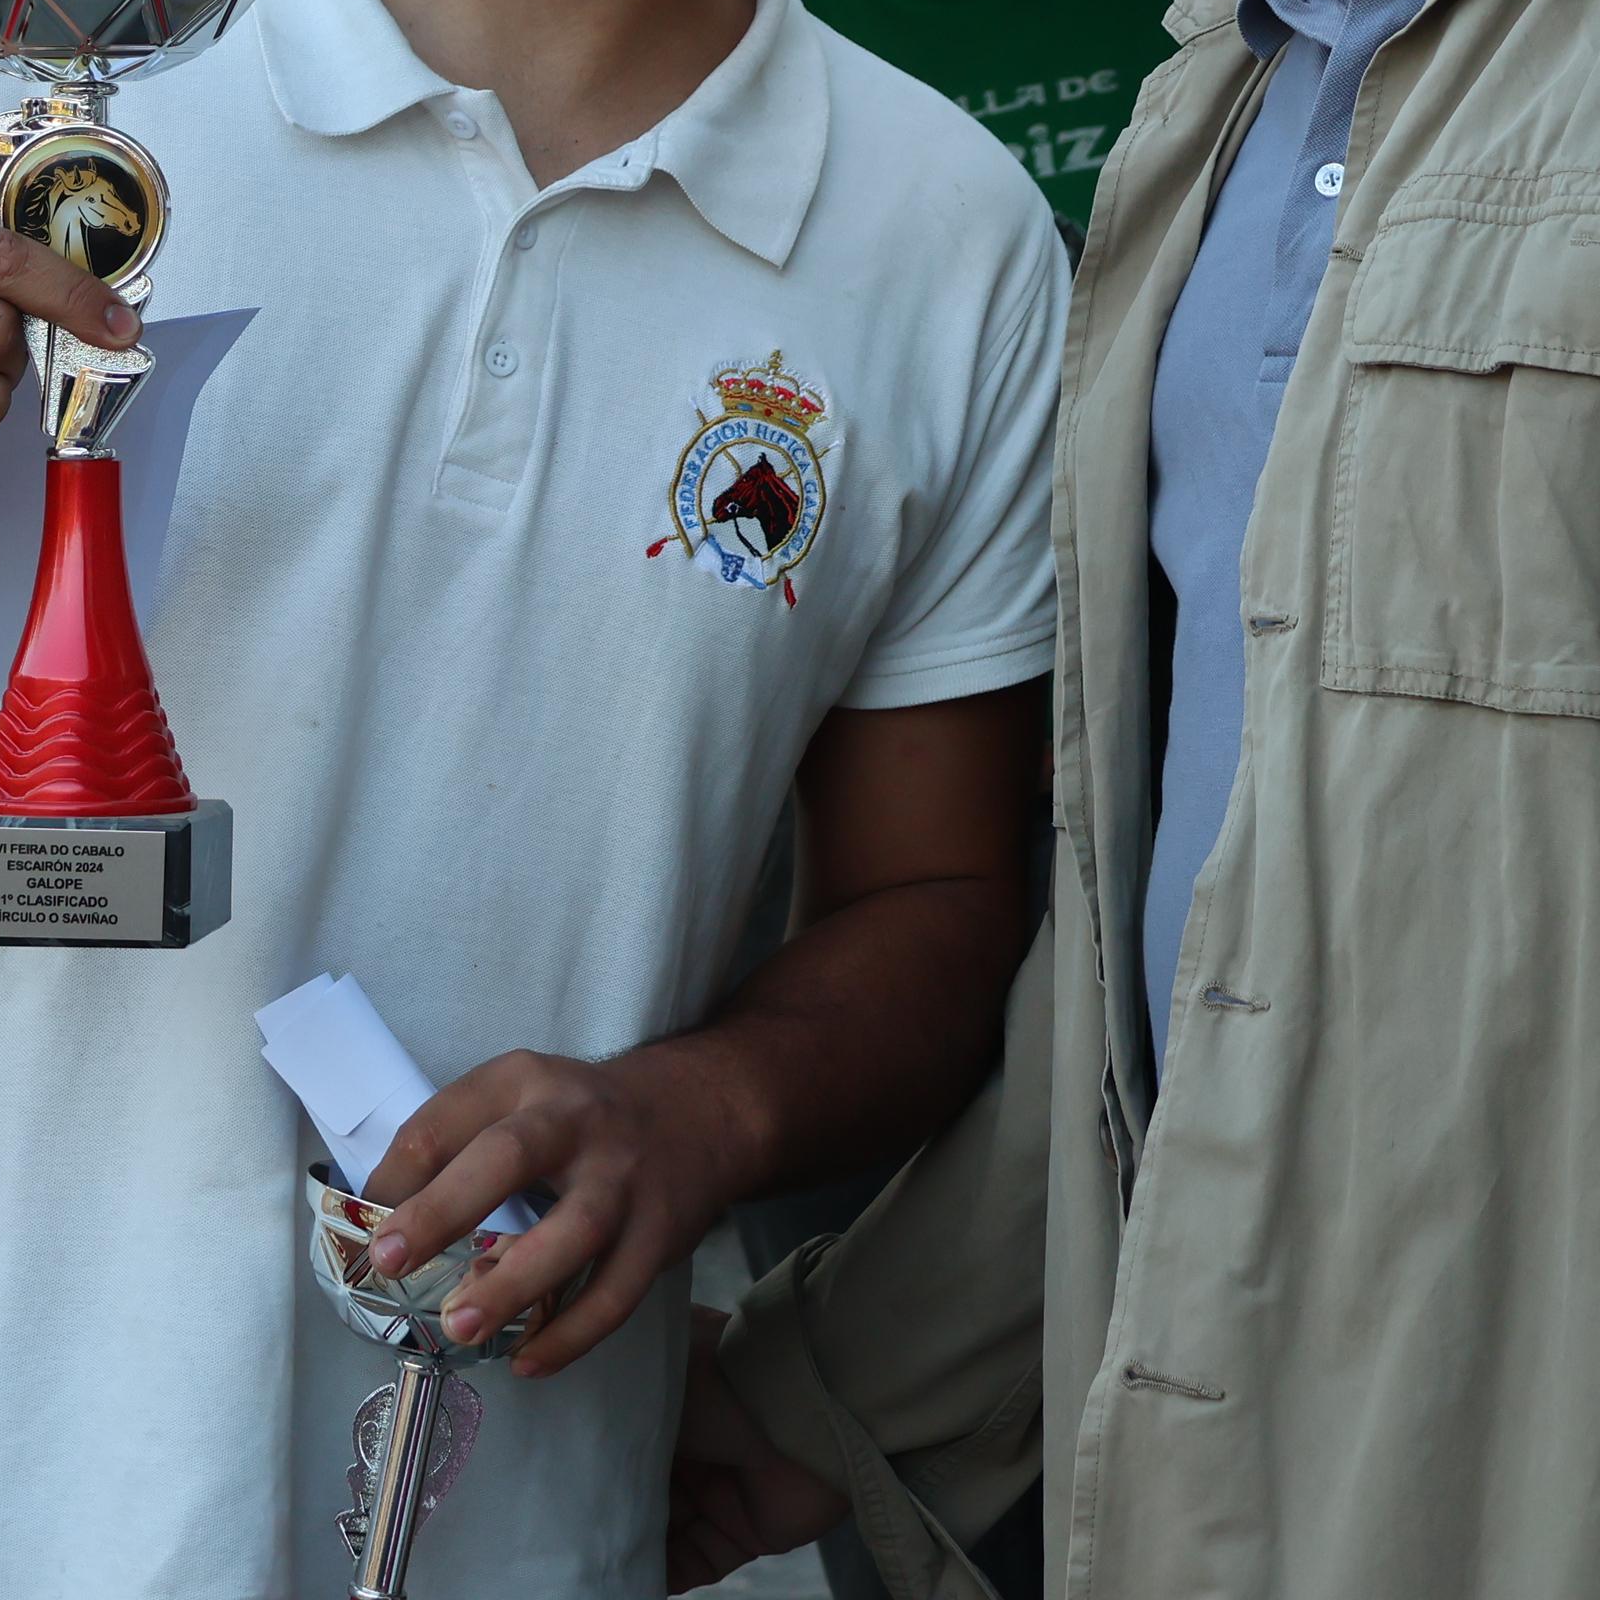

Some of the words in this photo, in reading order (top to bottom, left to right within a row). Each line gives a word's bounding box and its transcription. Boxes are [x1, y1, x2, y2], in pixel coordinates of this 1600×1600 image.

[10, 843, 48, 856] FEIRA
[50, 844, 70, 856] DO
[72, 845, 125, 858] CABALO
[6, 859, 73, 873] ESCAIRÓN
[75, 862, 104, 873] 2024
[26, 877, 83, 890] GALOPE
[16, 894, 109, 909] CLASIFICADO
[48, 912, 60, 924] O
[61, 911, 119, 926] SAVIÑAO
